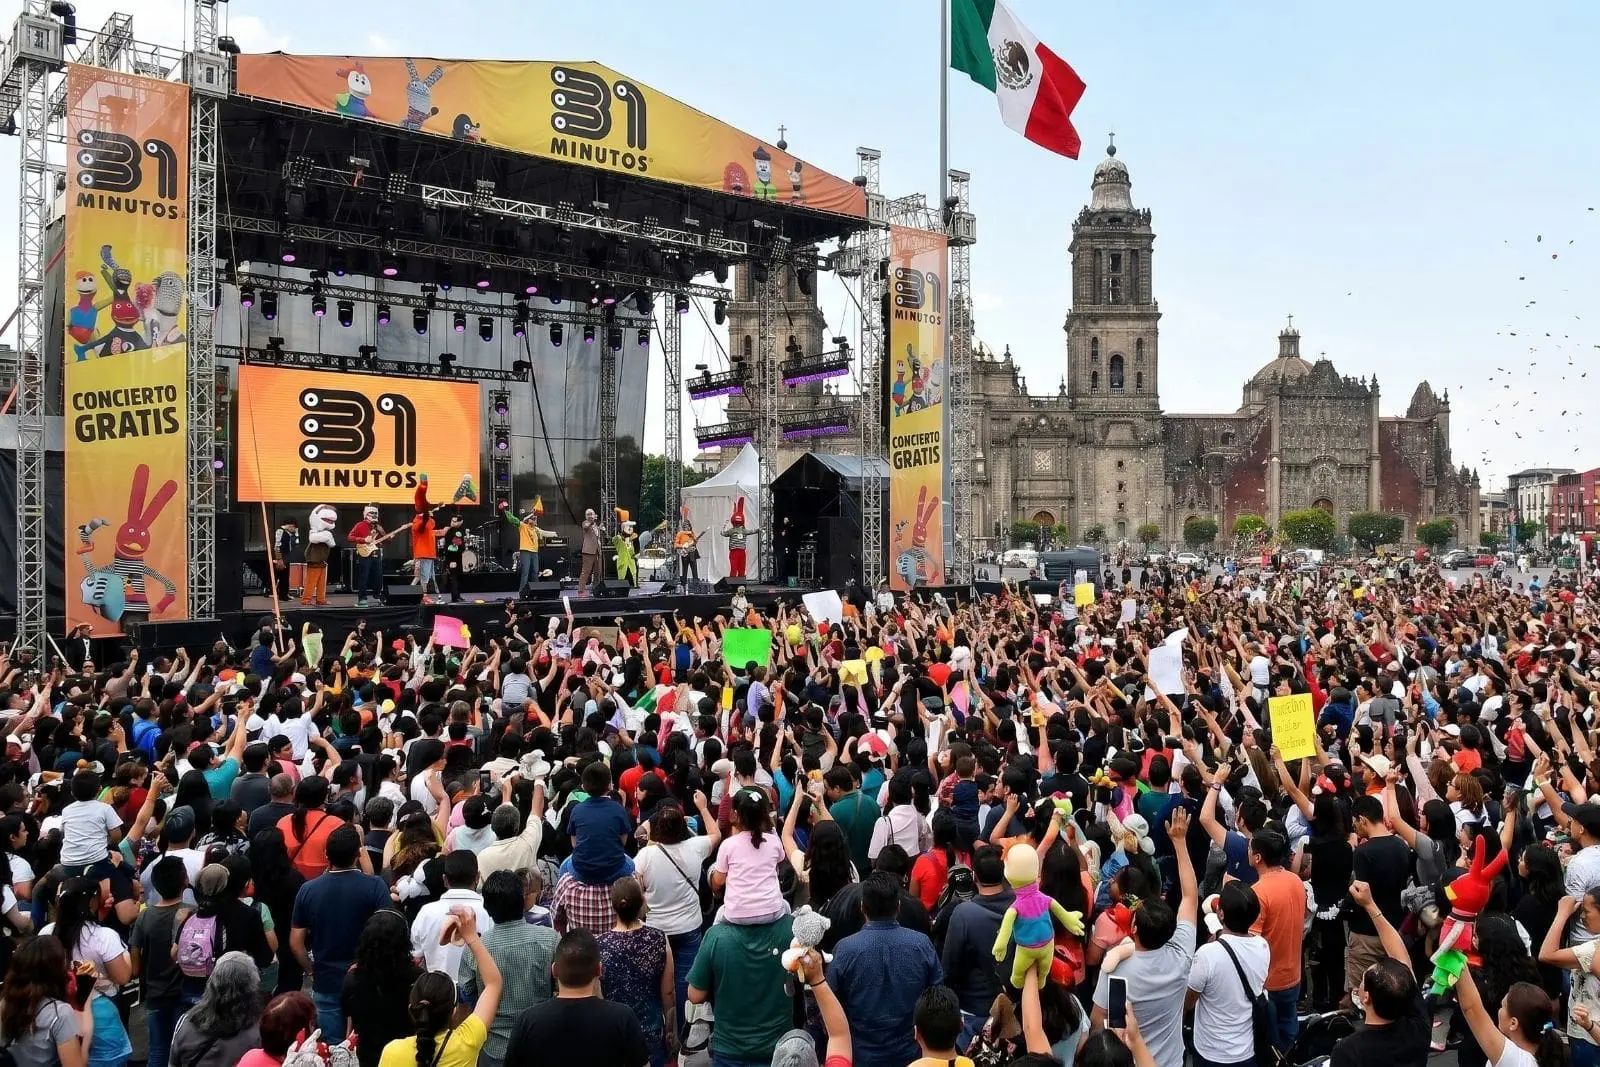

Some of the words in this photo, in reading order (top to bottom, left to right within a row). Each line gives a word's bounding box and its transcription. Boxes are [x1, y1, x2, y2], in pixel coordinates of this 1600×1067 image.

[551, 66, 647, 151] 31
[77, 129, 177, 200] 31
[550, 137, 648, 172] MINUTOS
[77, 192, 178, 219] MINUTOS
[895, 267, 940, 313] 31
[895, 309, 942, 325] MINUTOS
[73, 385, 177, 411] CONCIERTO
[75, 407, 180, 442] GRATIS
[299, 388, 416, 467] 31
[892, 431, 940, 449] CONCIERTO
[893, 445, 940, 470] GRATIS
[300, 468, 418, 489] MINUTOS
